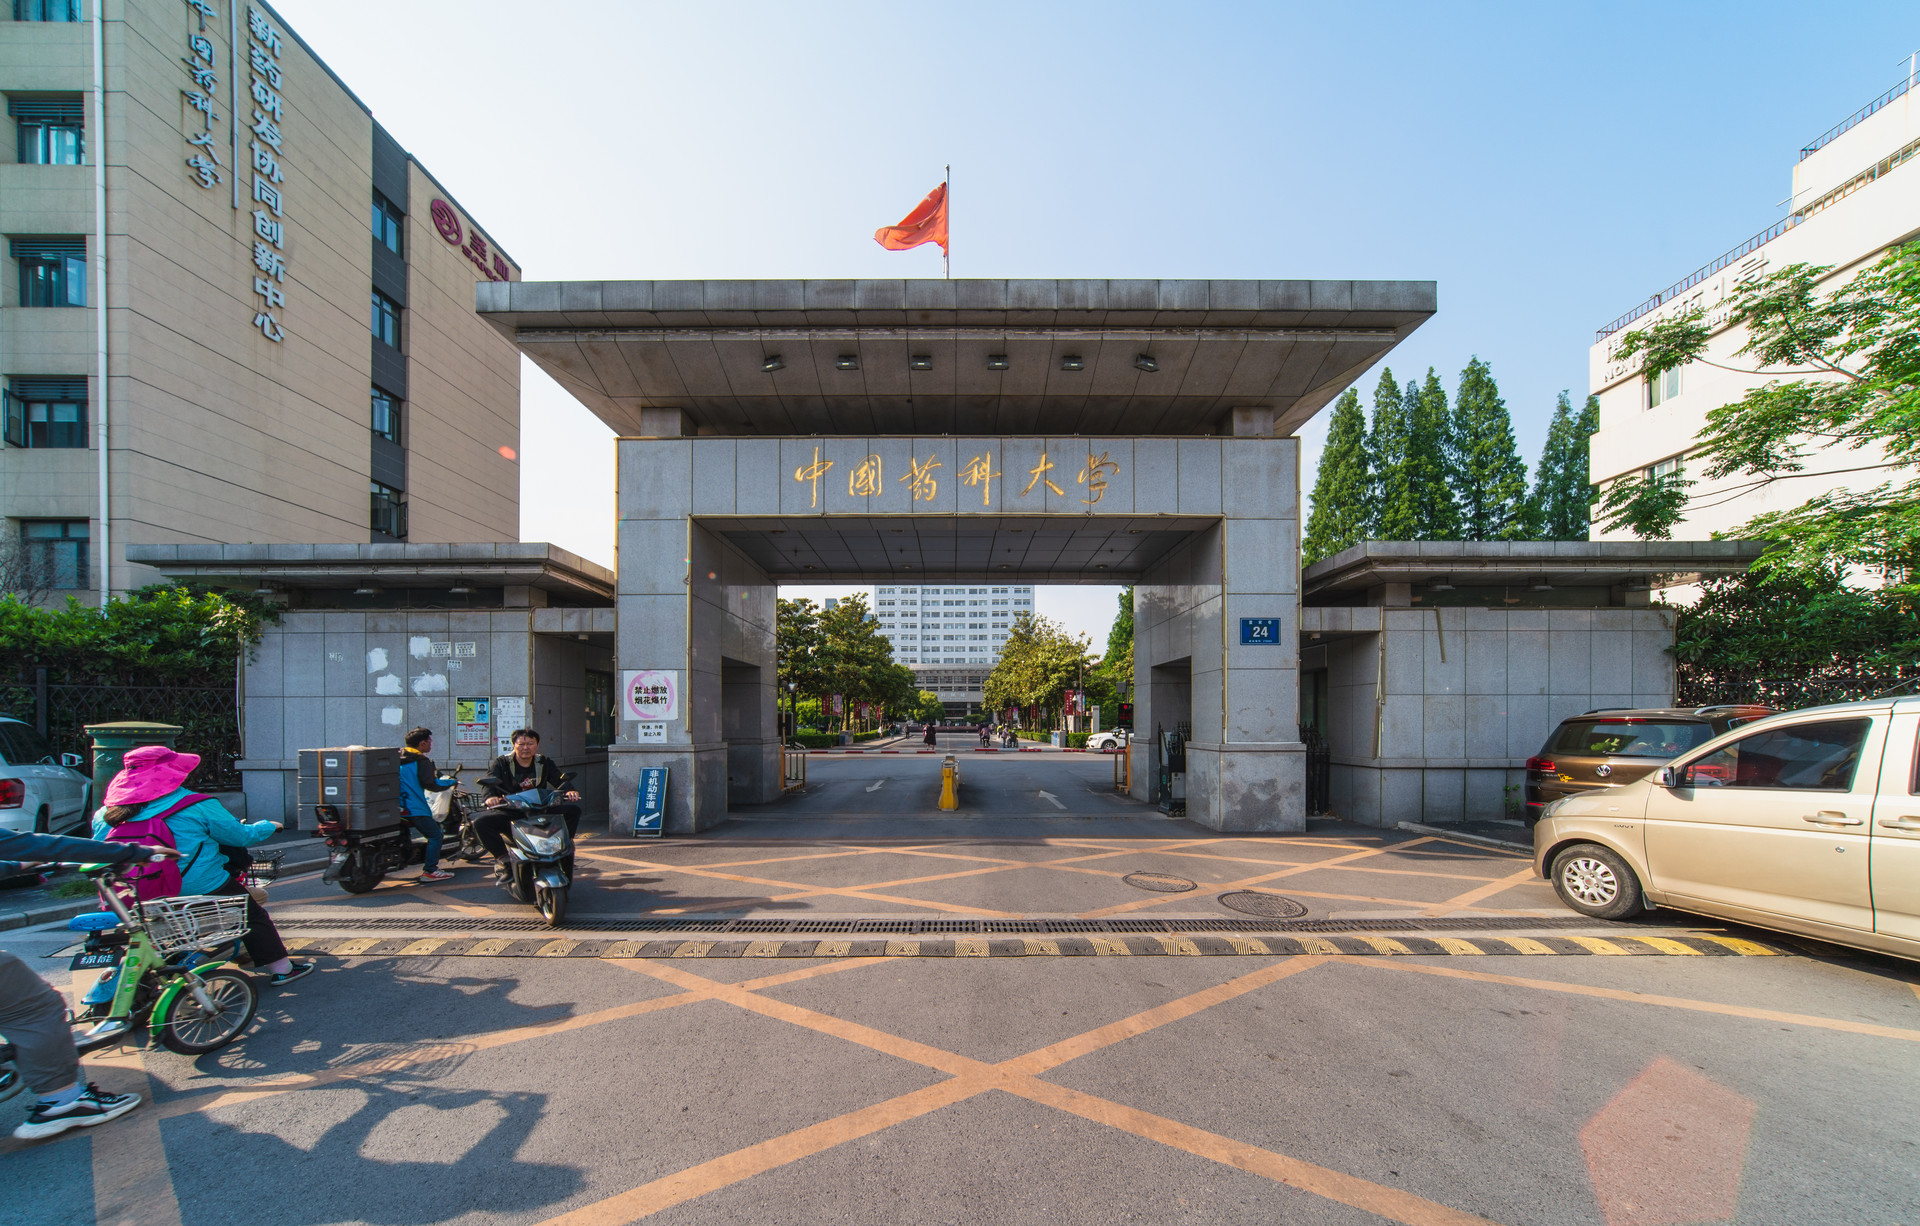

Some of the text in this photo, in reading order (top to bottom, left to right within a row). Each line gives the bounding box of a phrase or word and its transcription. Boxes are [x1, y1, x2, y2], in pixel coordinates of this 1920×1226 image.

[247, 6, 285, 343] 新药研发协同创新中心
[1252, 627, 1268, 637] 24
[634, 686, 668, 695] 禁止燃放
[634, 696, 668, 705] 烟花爆竹
[645, 770, 659, 809] 非机动车道
